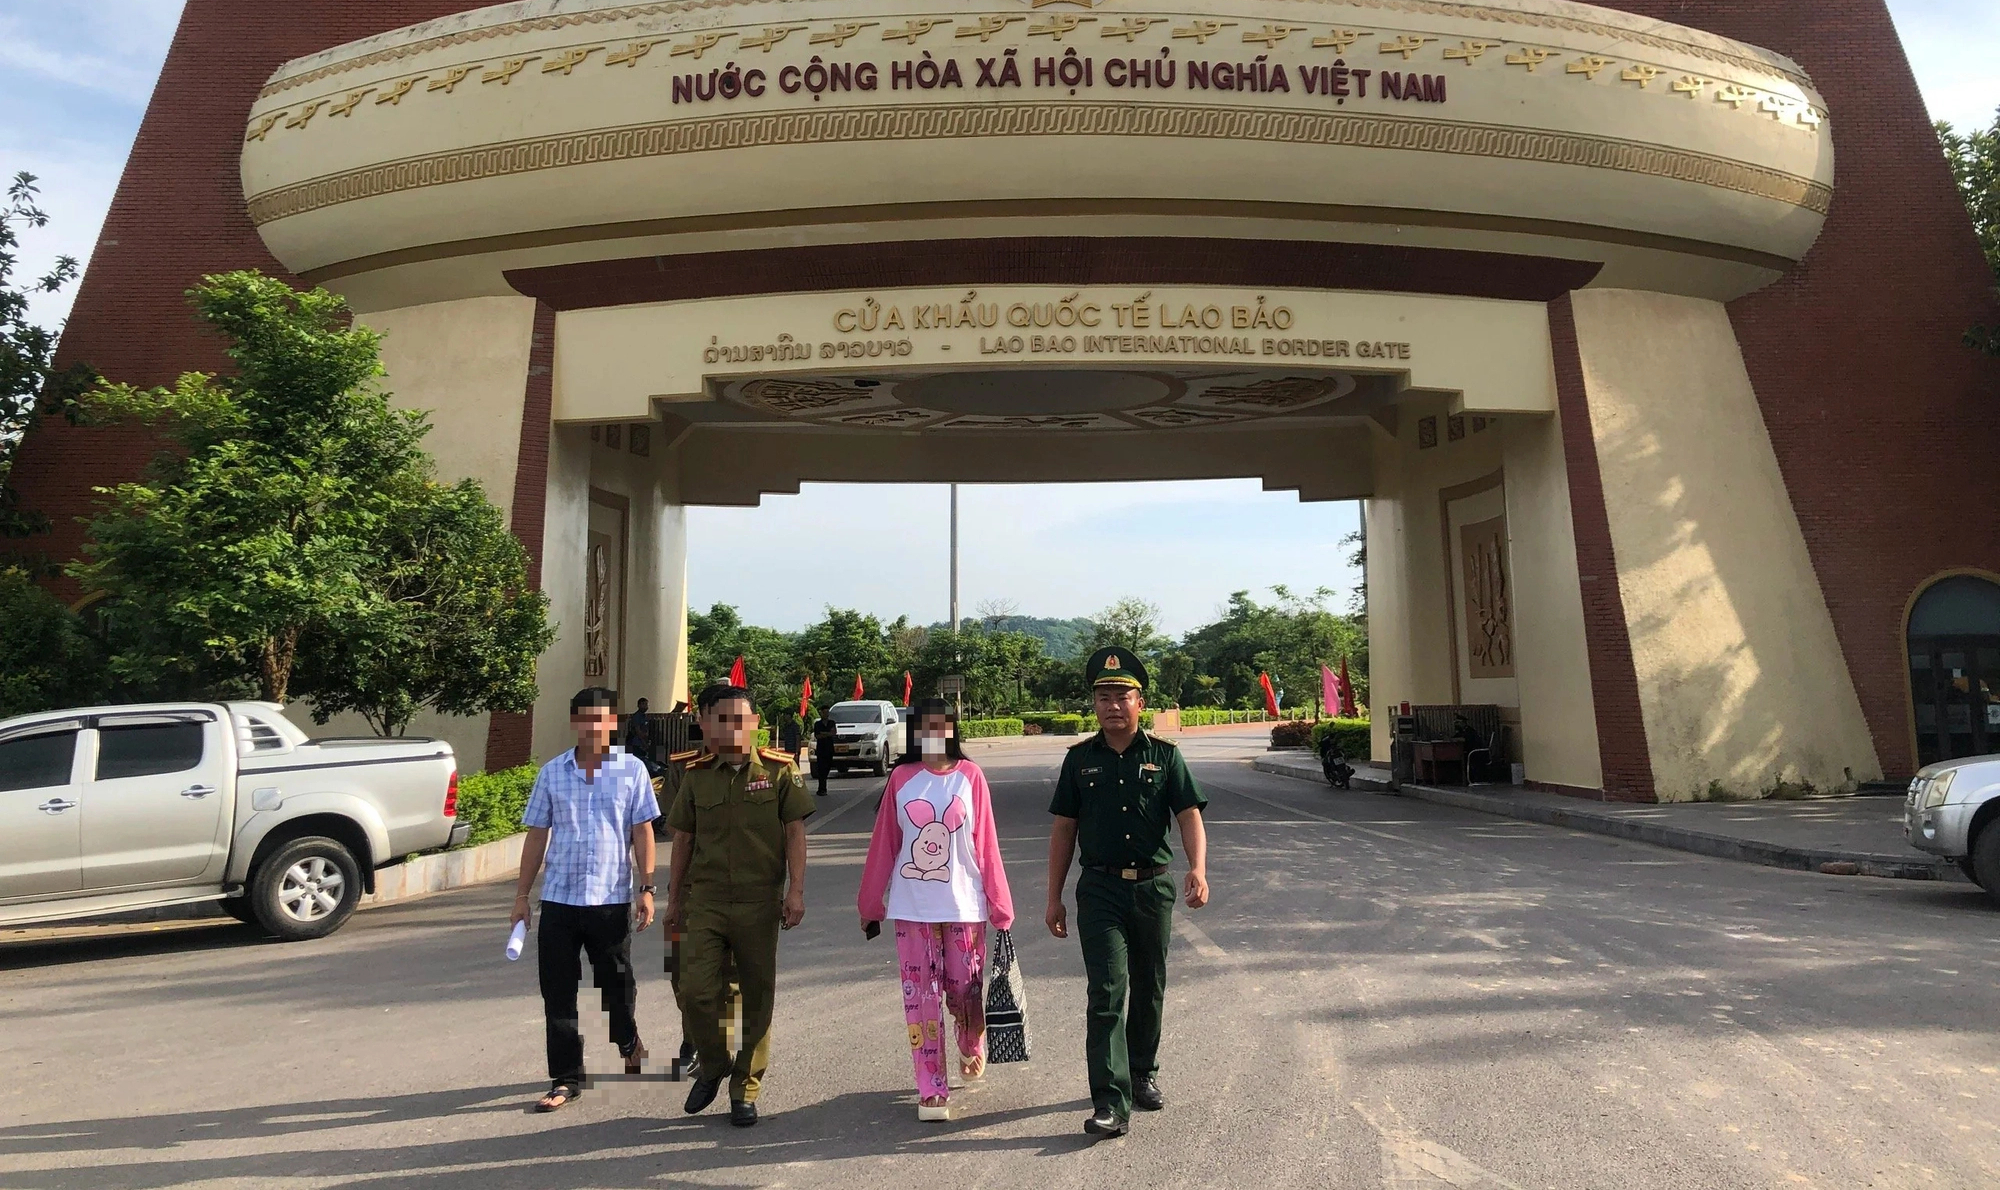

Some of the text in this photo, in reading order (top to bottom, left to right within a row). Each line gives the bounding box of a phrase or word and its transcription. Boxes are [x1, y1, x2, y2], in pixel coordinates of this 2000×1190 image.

[672, 46, 1447, 104] NƯỚC CỘNG HÒA XÃ HỘI CHỦ NGHĨA VIỆT NAM
[833, 289, 1294, 333] CỬA KHẨU QUỐC TẾ LAO BẢO
[980, 335, 1024, 354] LAO
[1030, 335, 1076, 353] BAO
[1083, 335, 1255, 355] INTERNATIONAL
[1262, 338, 1350, 358] BORDER
[1355, 340, 1411, 360] GATE
